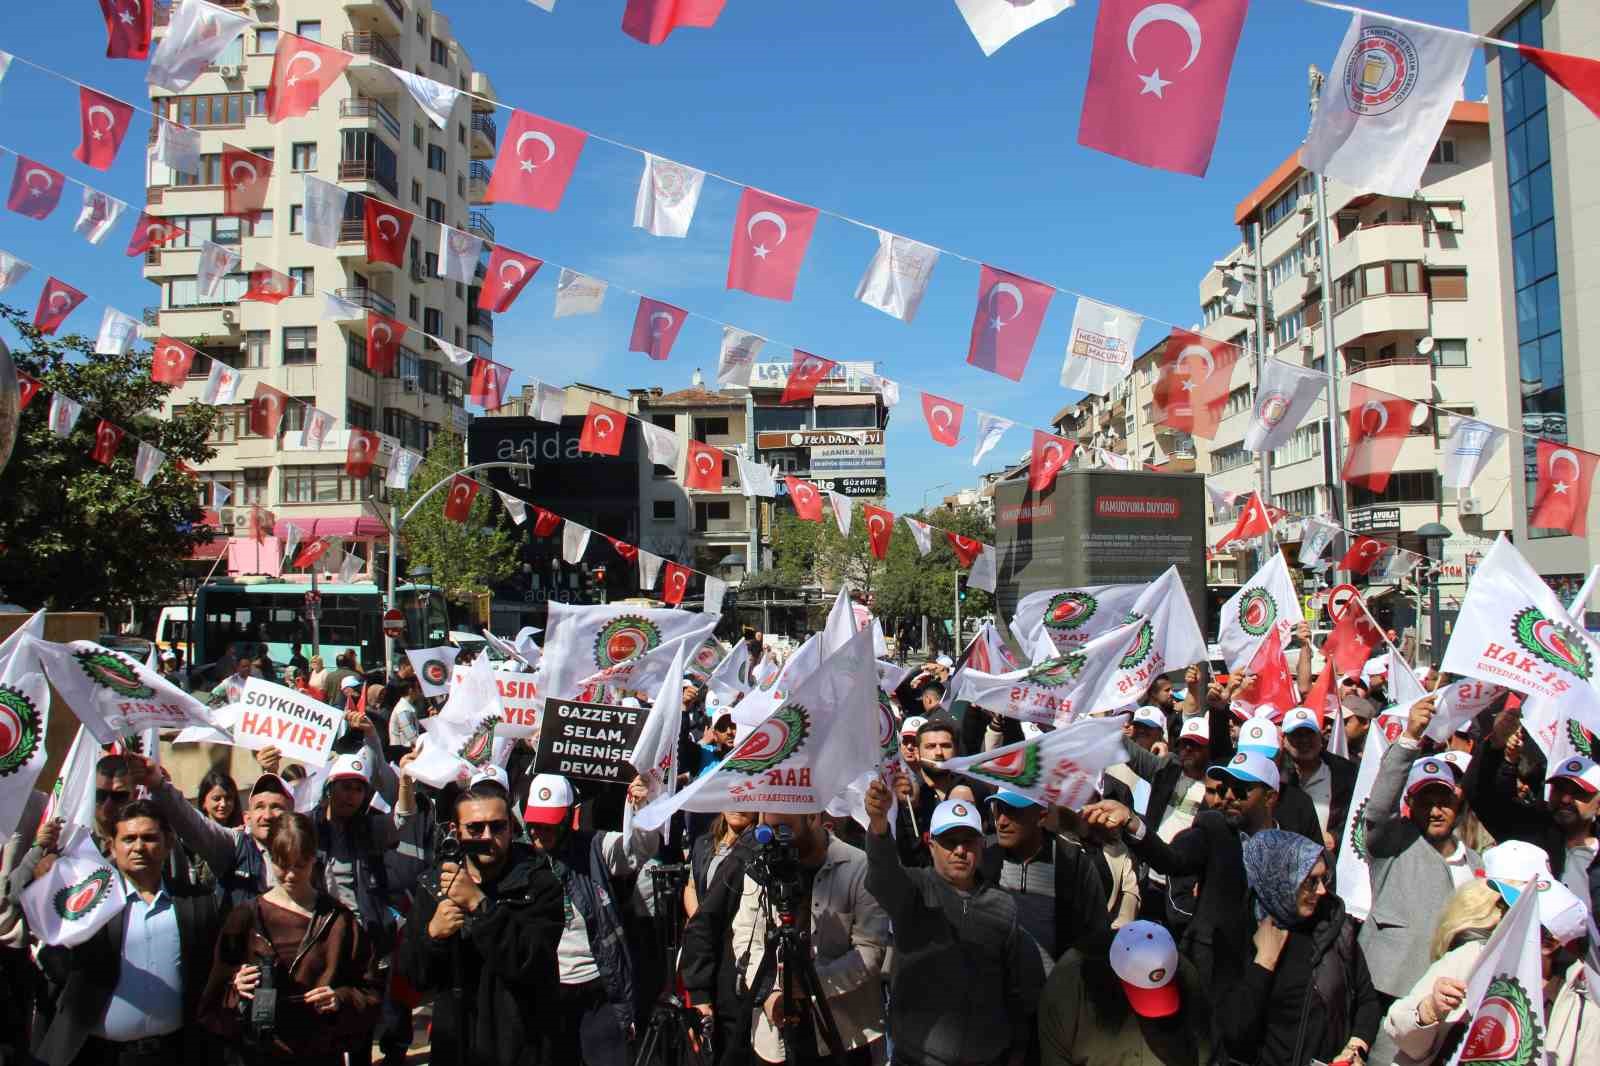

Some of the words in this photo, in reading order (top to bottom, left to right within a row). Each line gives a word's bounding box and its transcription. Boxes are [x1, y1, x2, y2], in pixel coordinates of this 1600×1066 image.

[497, 432, 606, 460] adda
[845, 486, 876, 494] Salonu
[1373, 510, 1399, 520] AVUKAT
[246, 691, 333, 730] SOYKIRIMA
[558, 706, 637, 725] GAZZE'YE
[241, 712, 328, 752] HAYIR!
[563, 724, 626, 744] SELAM,
[552, 740, 632, 762] DİRENİŞE
[560, 760, 619, 778] DEVAM
